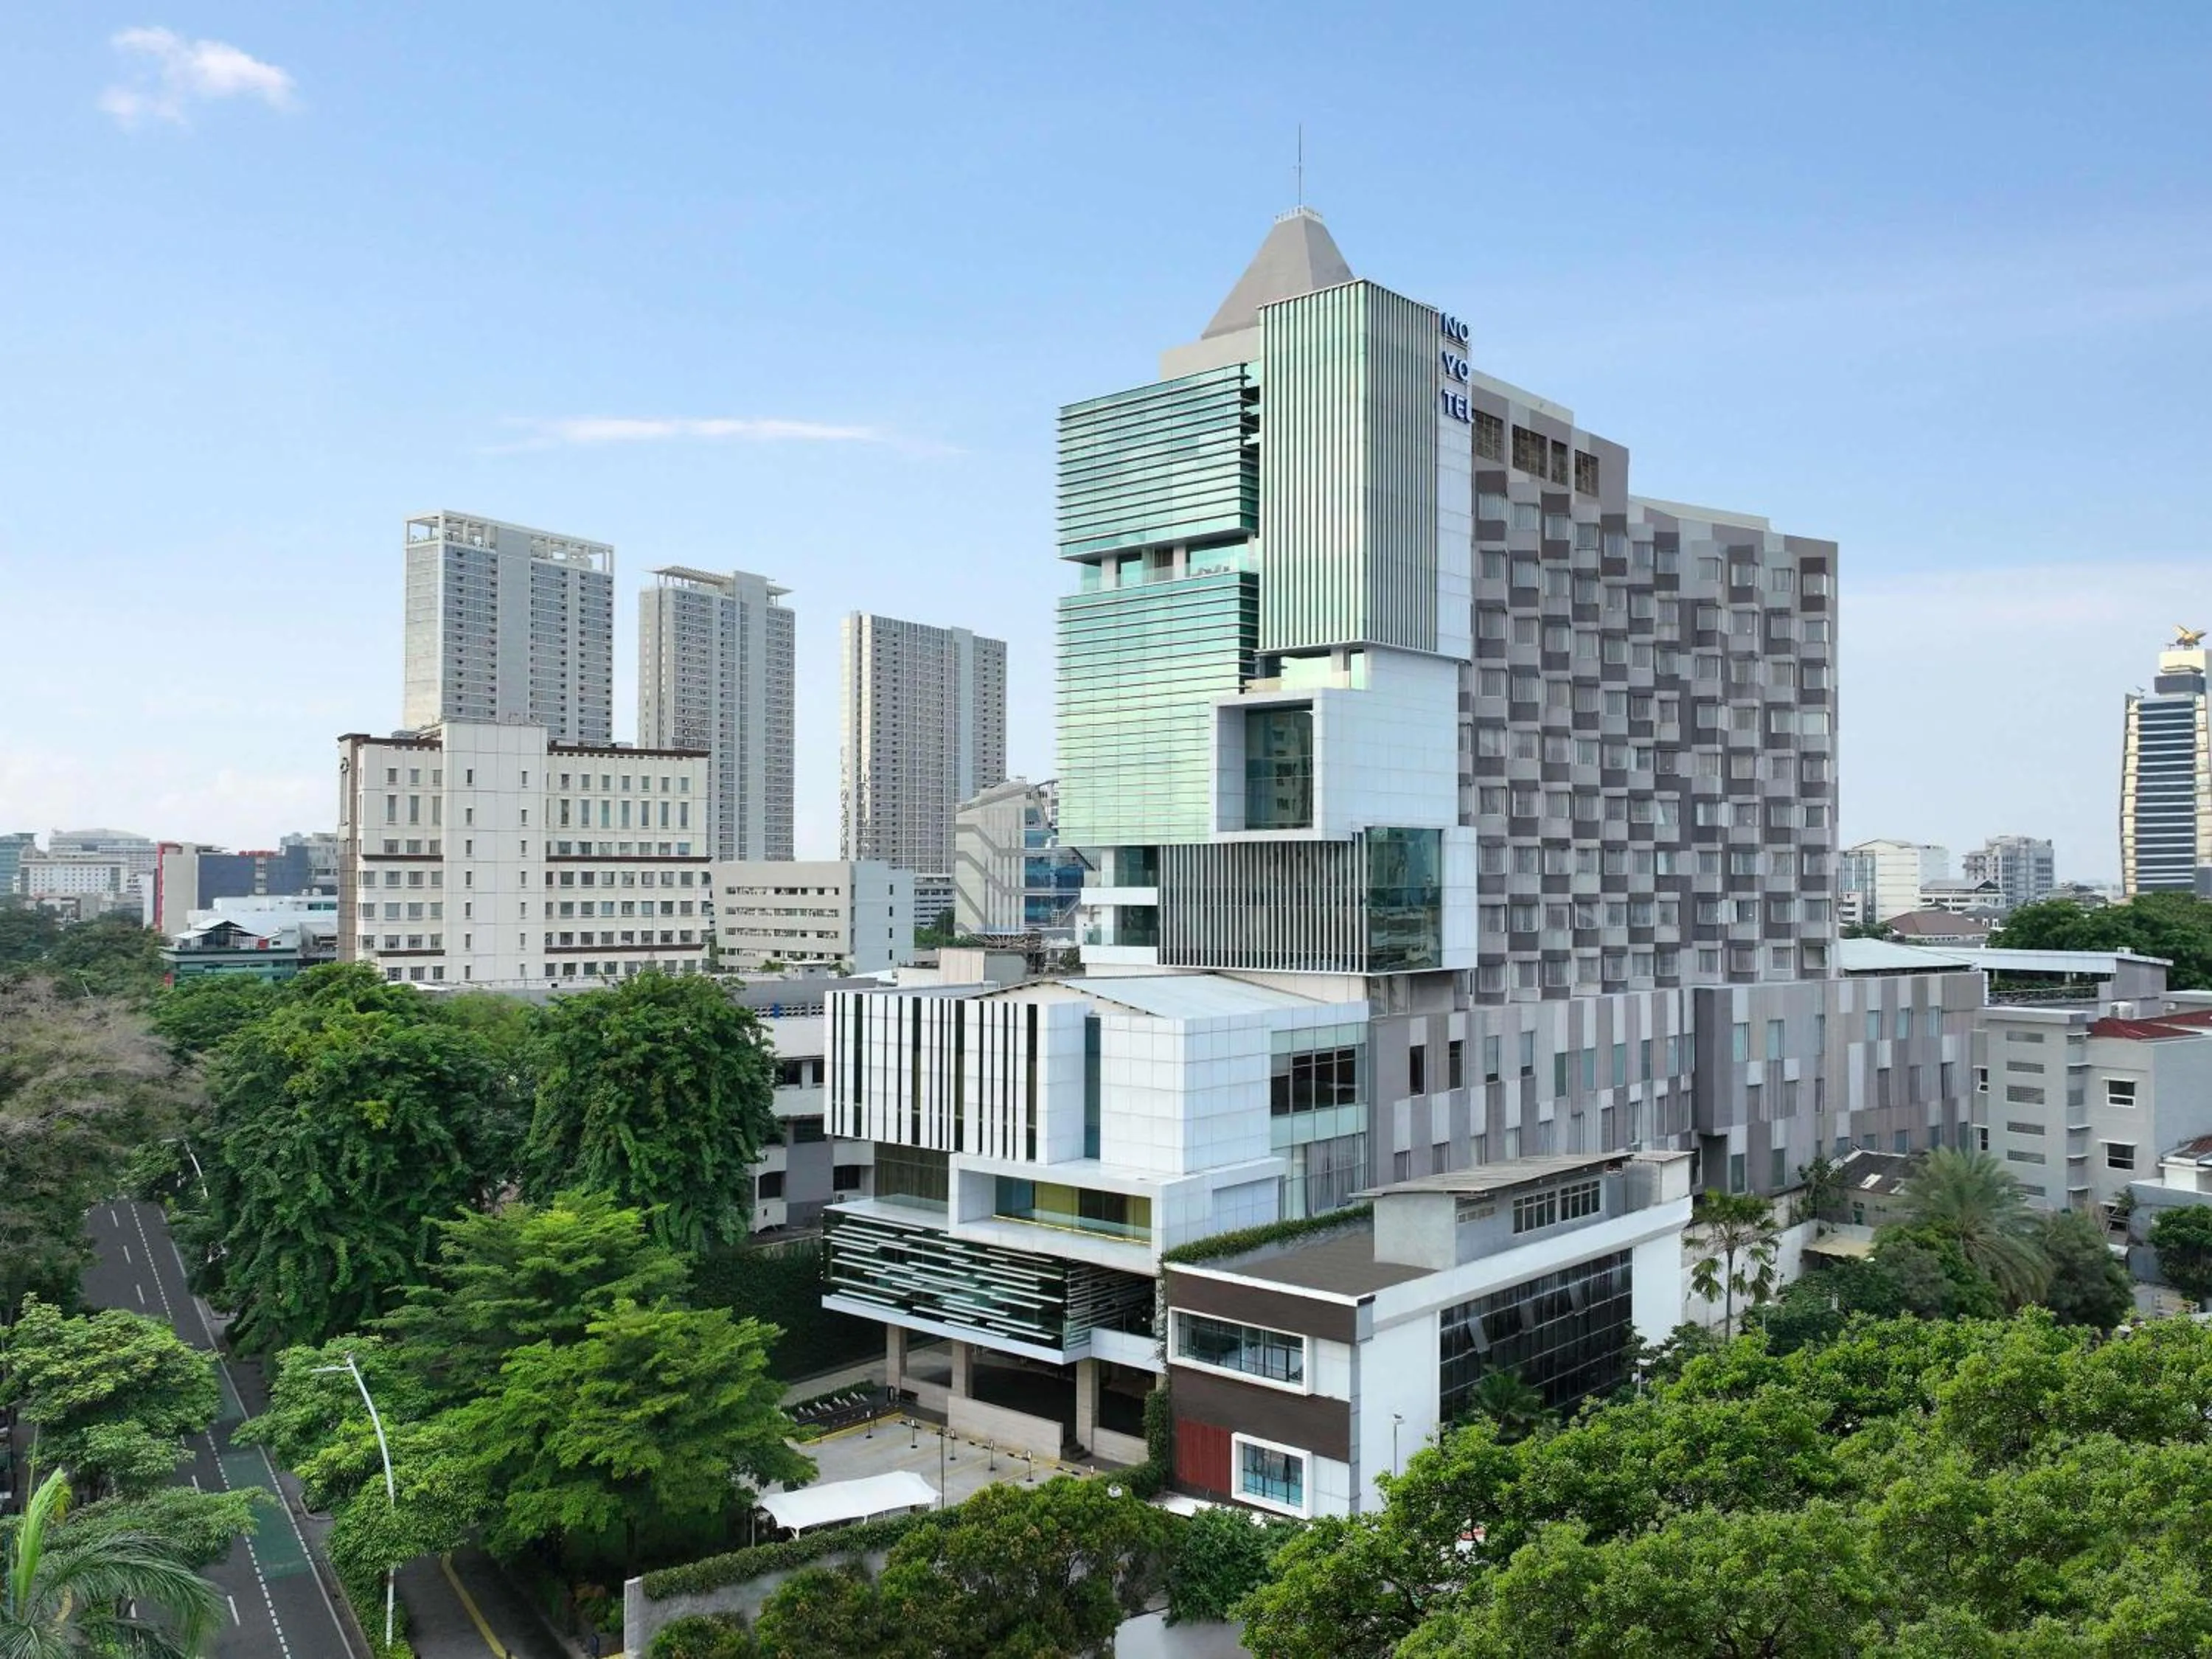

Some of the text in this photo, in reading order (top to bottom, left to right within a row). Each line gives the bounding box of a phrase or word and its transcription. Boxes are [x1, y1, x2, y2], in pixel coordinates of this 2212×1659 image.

[1441, 313, 1469, 342] NO
[1442, 351, 1469, 381] VO
[1441, 389, 1474, 422] TEL
